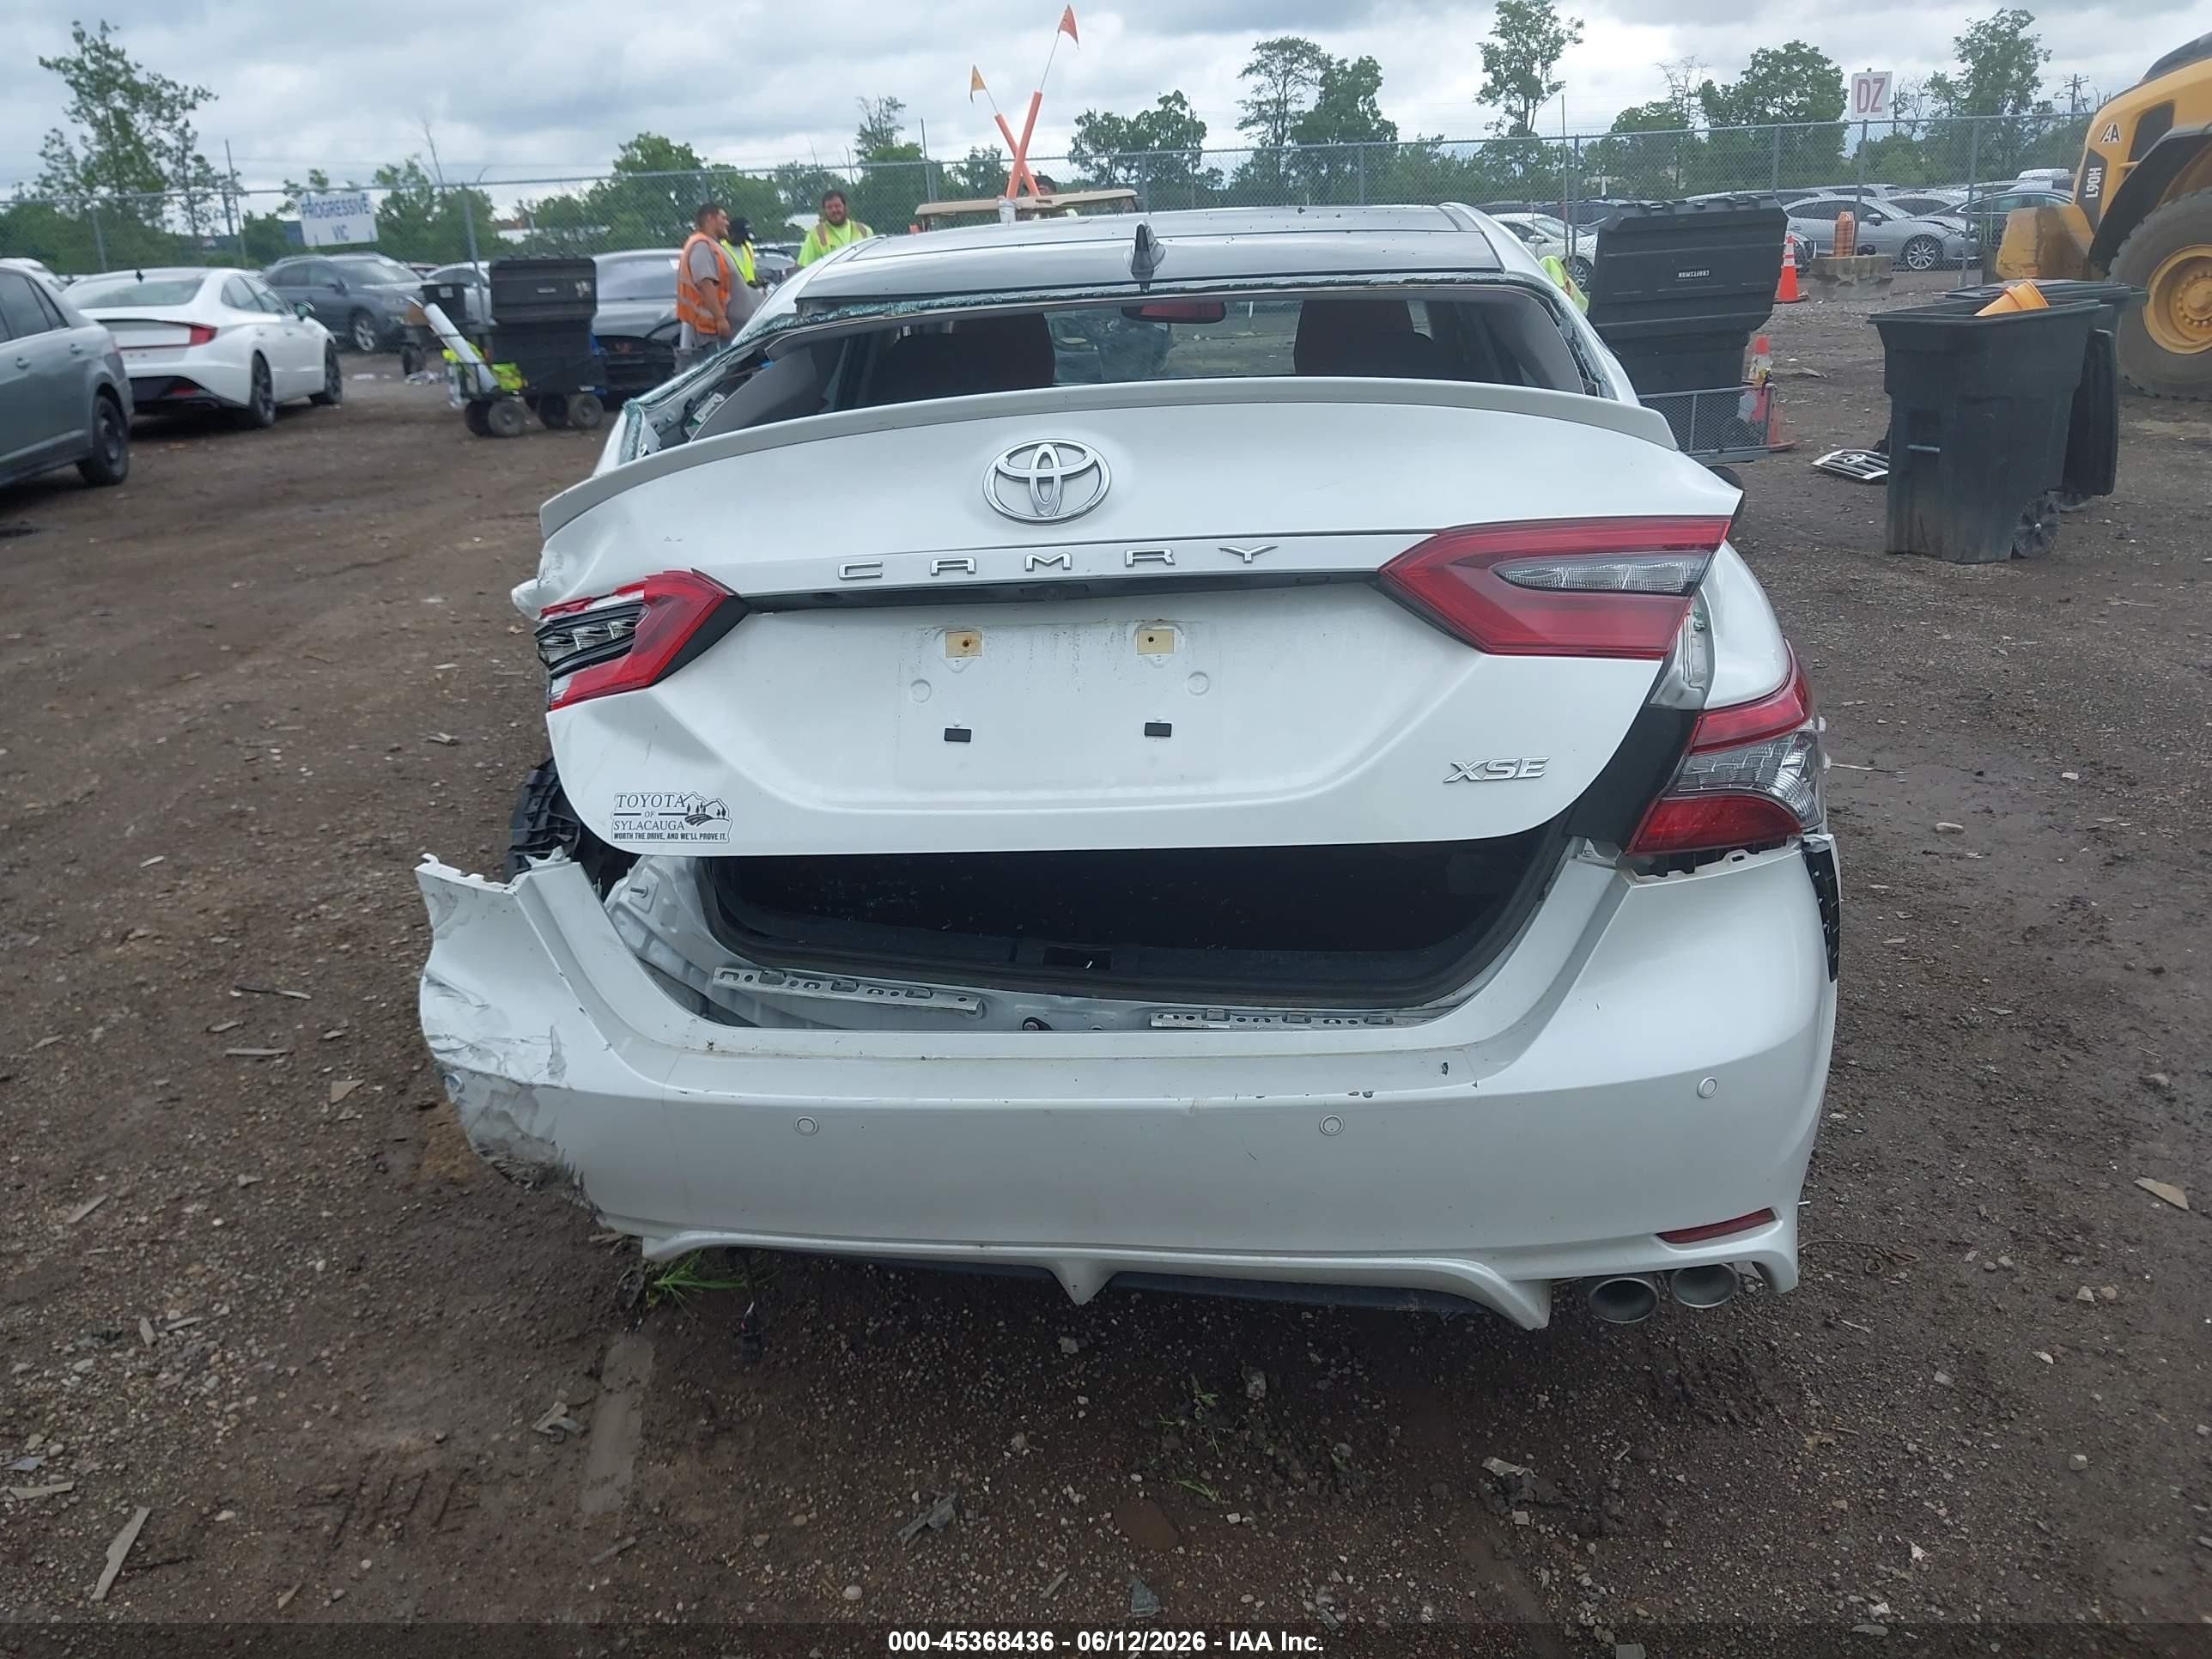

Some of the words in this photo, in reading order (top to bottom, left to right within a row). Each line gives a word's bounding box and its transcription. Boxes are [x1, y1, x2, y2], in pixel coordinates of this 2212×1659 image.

[1856, 77, 1886, 113] DZ
[2085, 167, 2102, 198] L90H
[837, 544, 1279, 580] CAMRY
[1443, 757, 1549, 783] XSE
[617, 794, 686, 808] TOYOTA
[613, 820, 685, 831] SYLACAUGA
[647, 832, 665, 841] DRIVE,
[699, 832, 719, 841] PROVE
